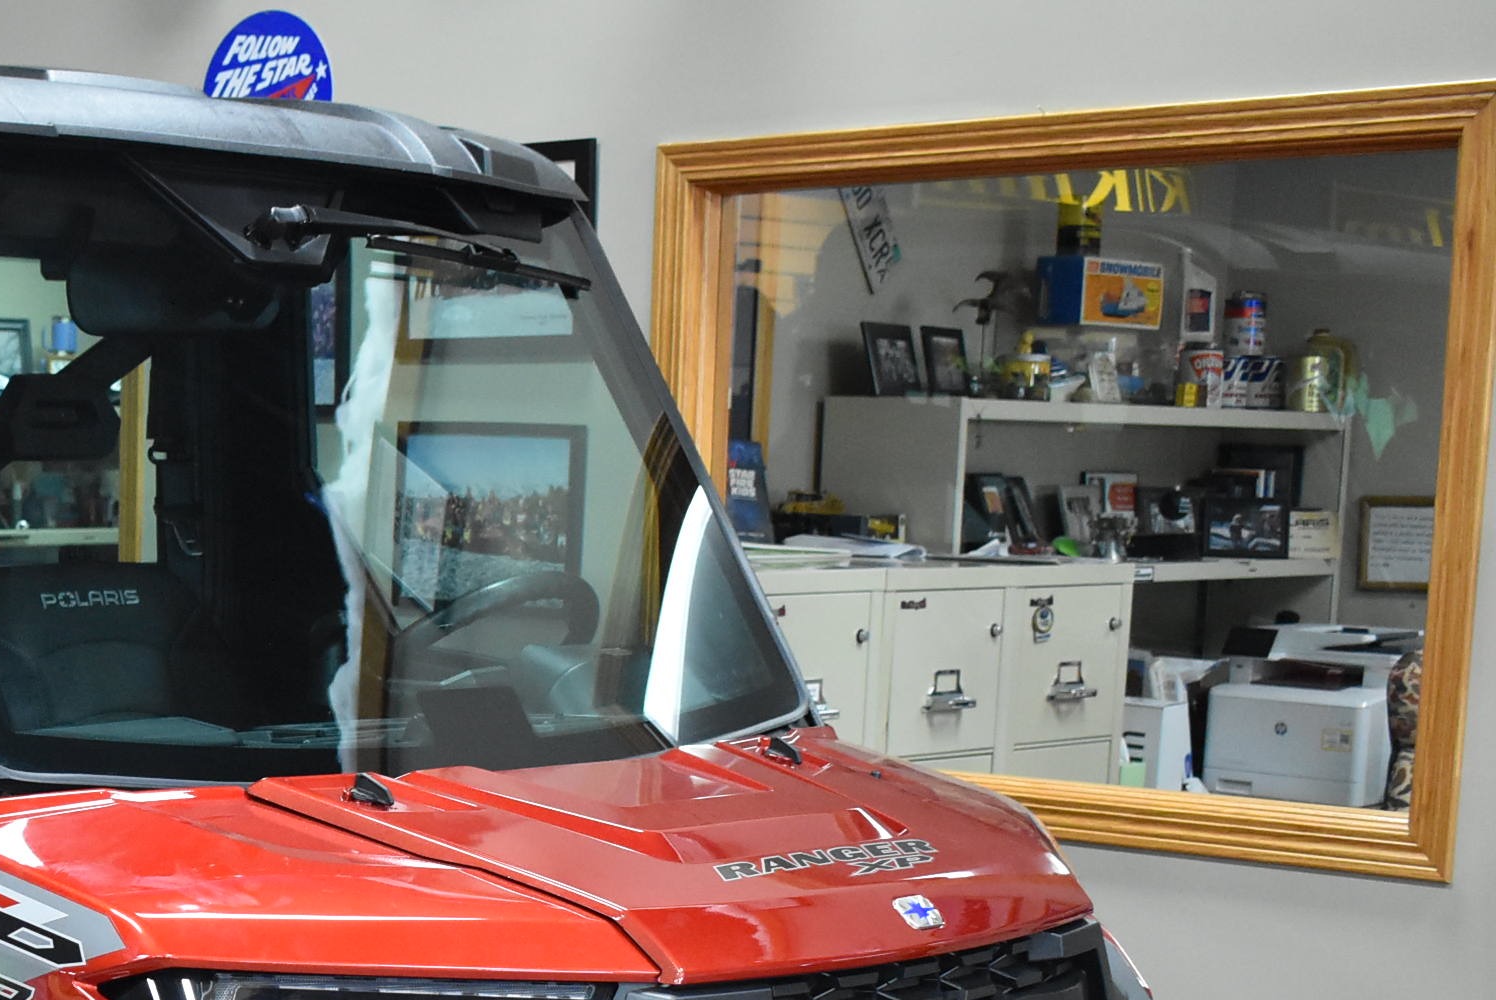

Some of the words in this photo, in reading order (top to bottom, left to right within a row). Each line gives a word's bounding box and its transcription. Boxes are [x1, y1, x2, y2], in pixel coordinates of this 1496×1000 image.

[222, 34, 300, 66] FOLLOW
[211, 63, 262, 98] THE
[255, 53, 314, 92] STAR
[1100, 260, 1162, 277] SNOWMOBILE
[40, 589, 140, 609] POLARIS
[714, 839, 939, 882] RANGER
[851, 854, 938, 877] XP
